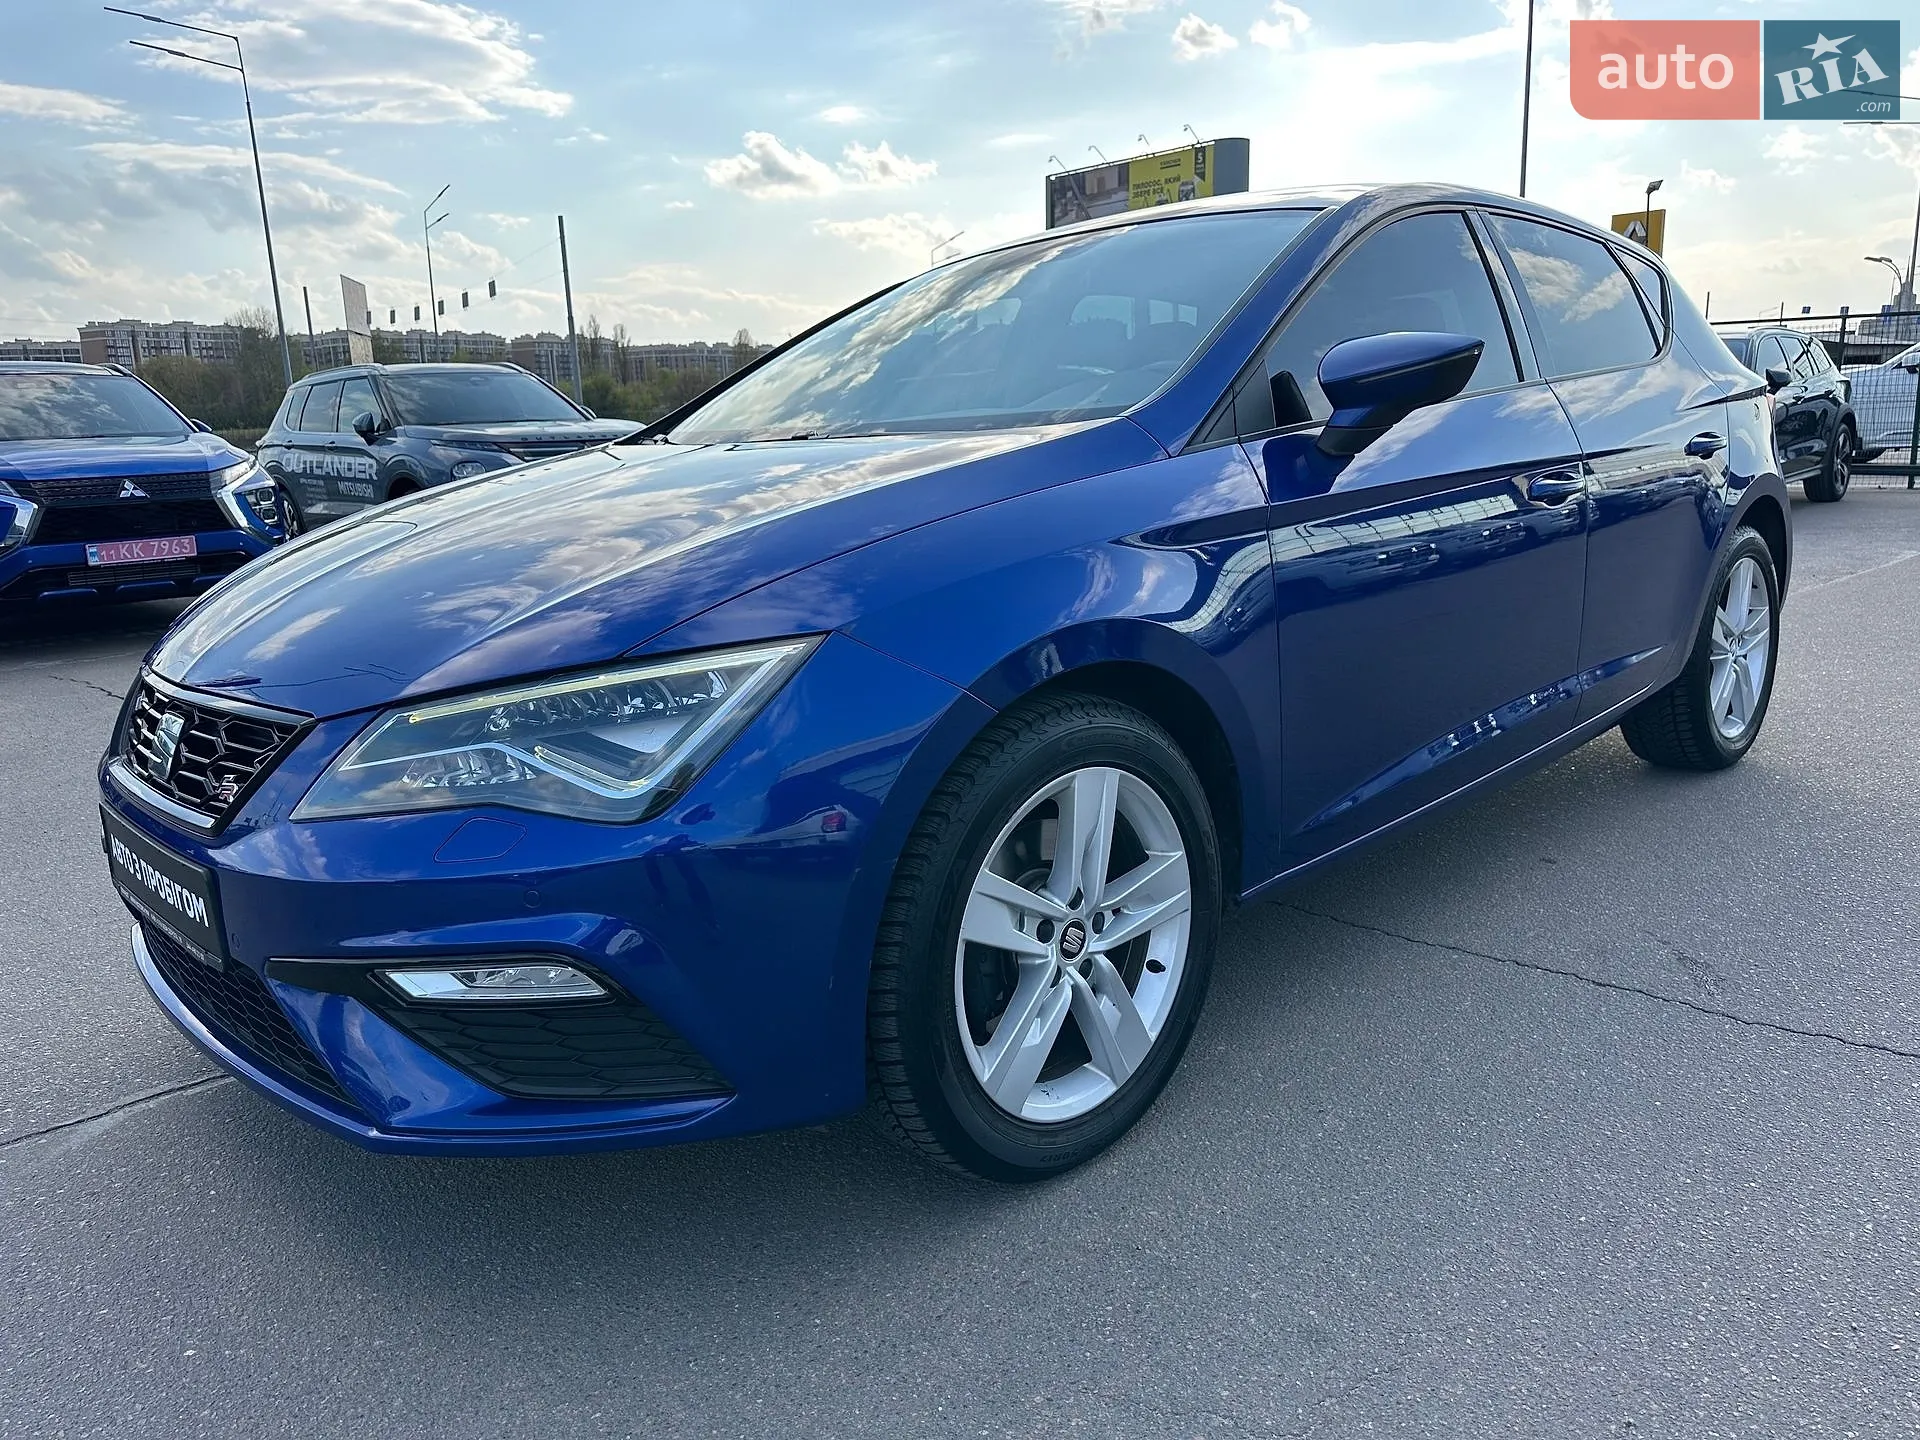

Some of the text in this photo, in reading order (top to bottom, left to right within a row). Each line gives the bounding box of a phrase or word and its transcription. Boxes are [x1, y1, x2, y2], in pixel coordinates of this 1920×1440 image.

[281, 452, 378, 481] OUTLANDER
[337, 480, 375, 498] MITSUBISHI
[100, 538, 191, 561] 11 KK 7963
[110, 833, 135, 875] АВТО
[140, 858, 210, 928] ПРОБІГОМ
